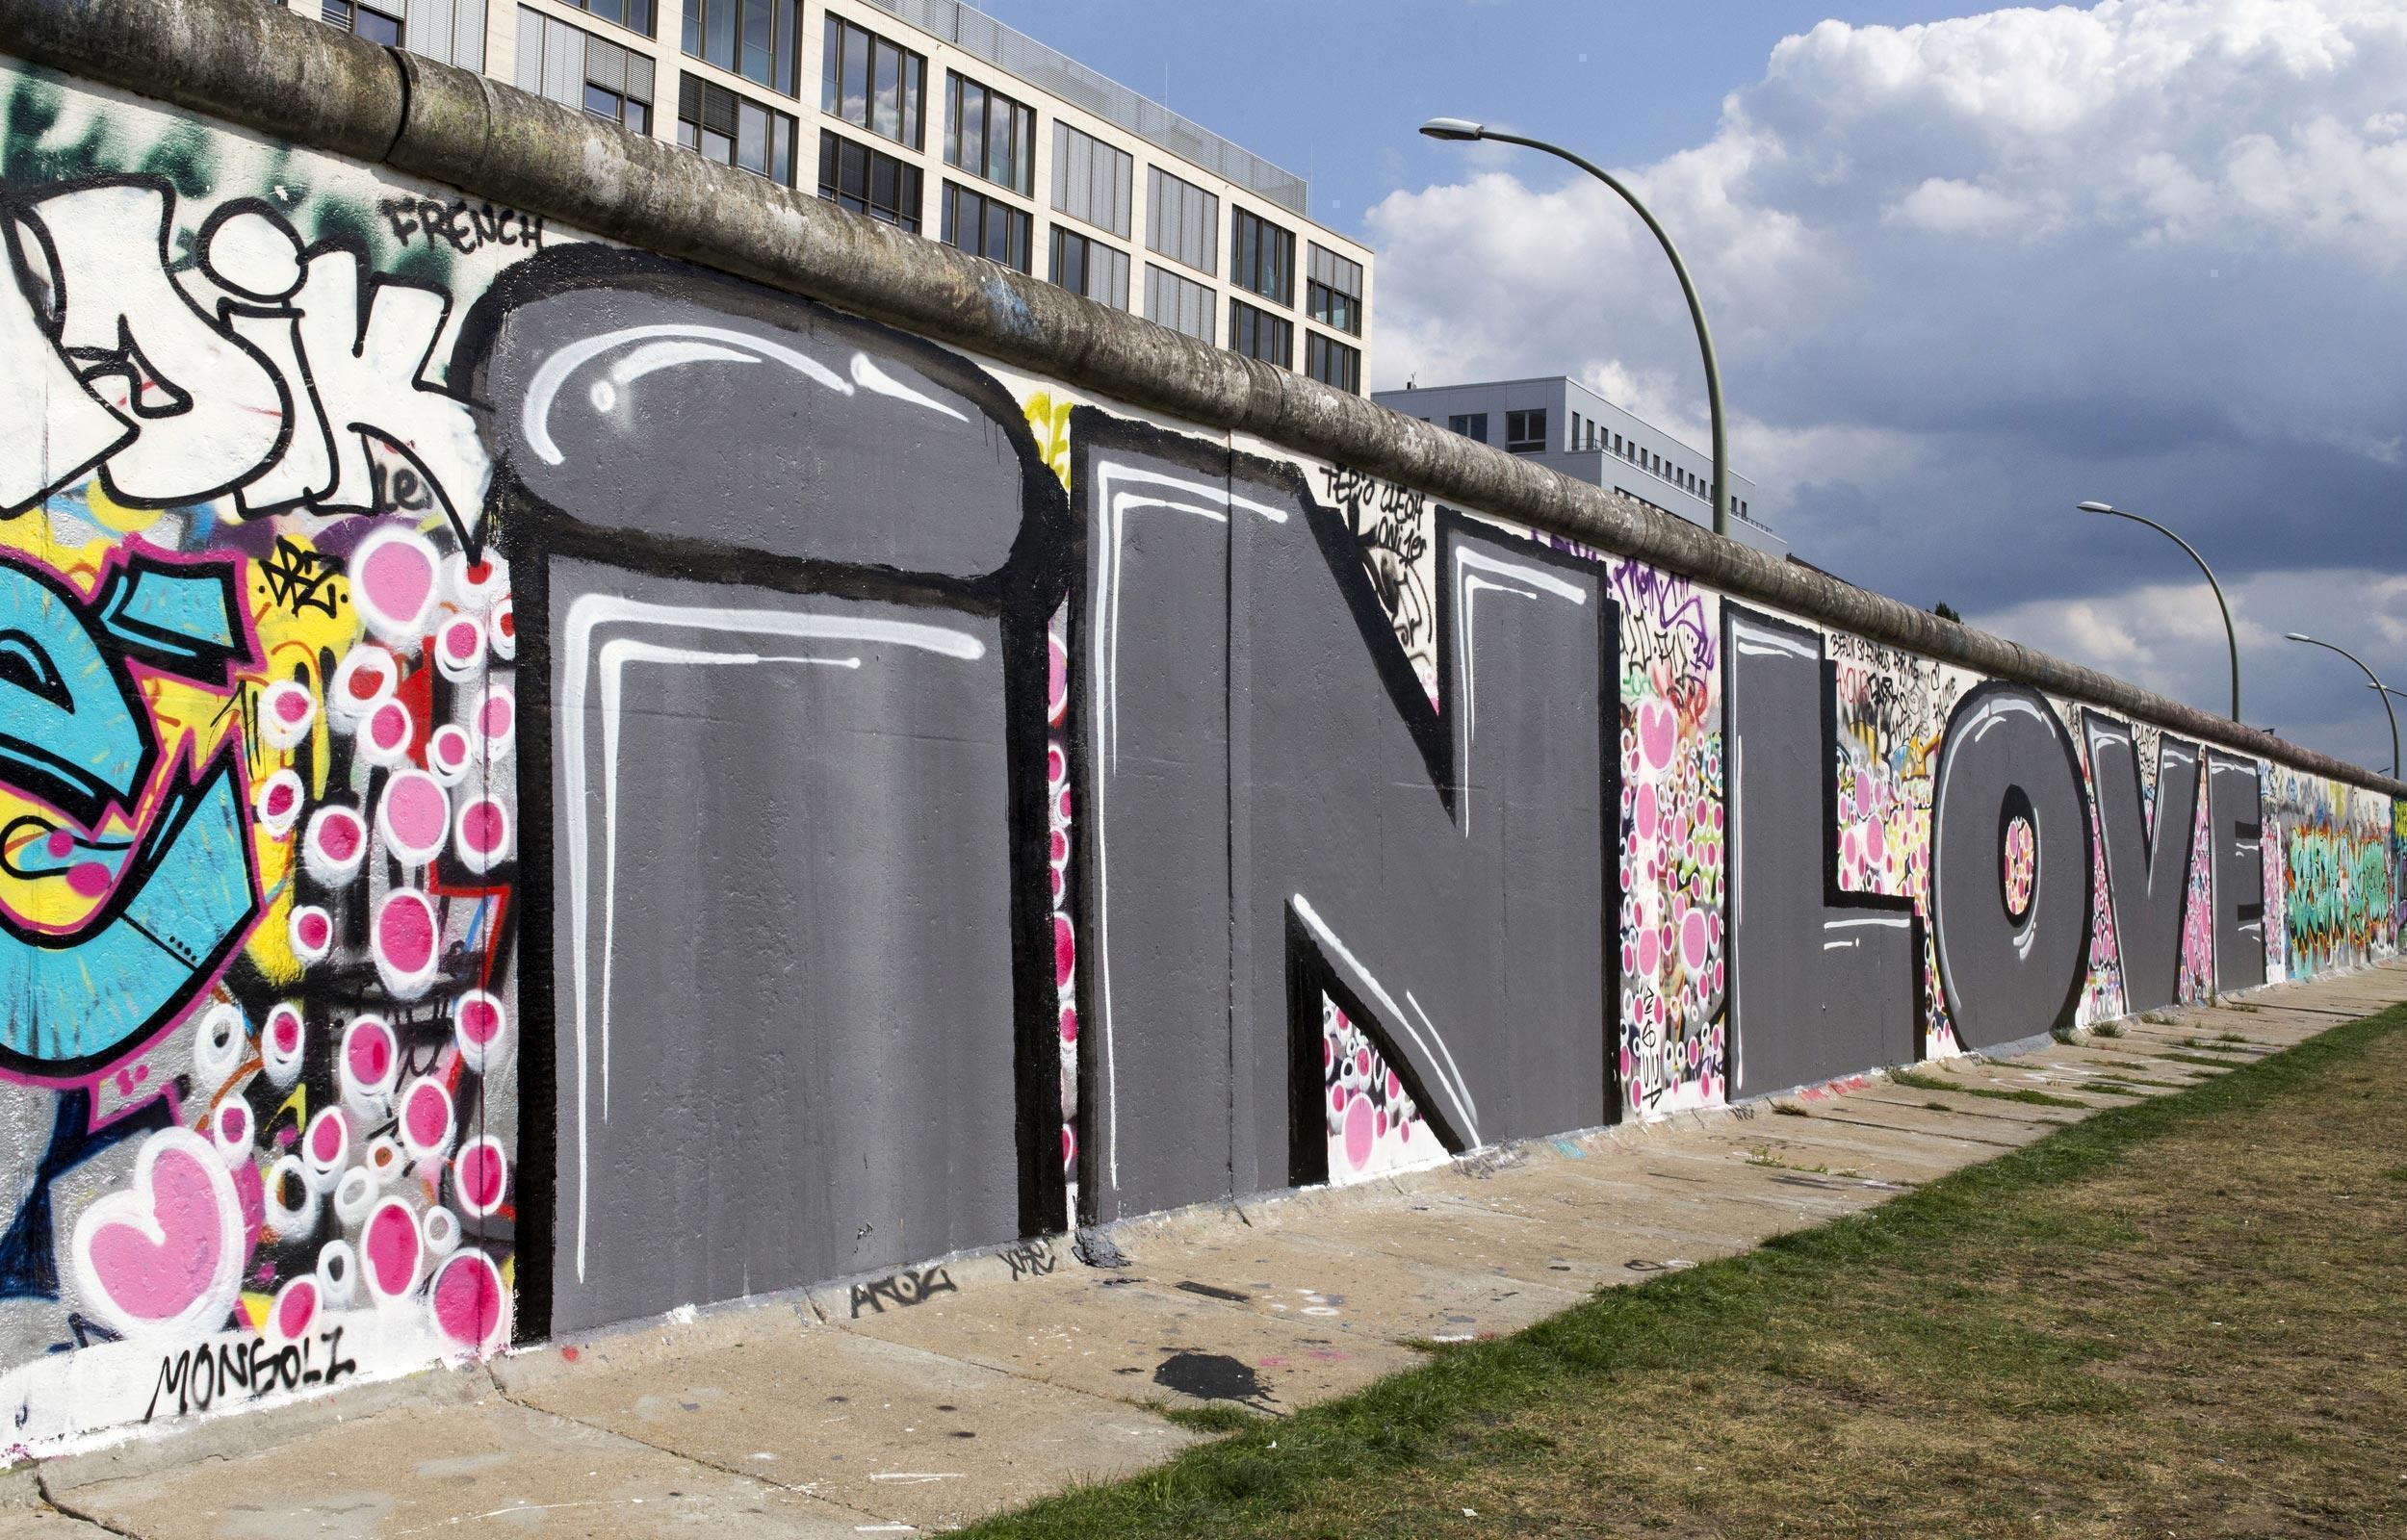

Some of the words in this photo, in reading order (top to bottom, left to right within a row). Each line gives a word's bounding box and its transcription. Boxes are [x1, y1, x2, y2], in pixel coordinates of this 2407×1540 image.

[376, 196, 544, 255] FRENCH
[1830, 633, 1855, 660] BERLIN
[1893, 651, 1906, 675] FOR
[1721, 594, 2266, 1103] LOVE
